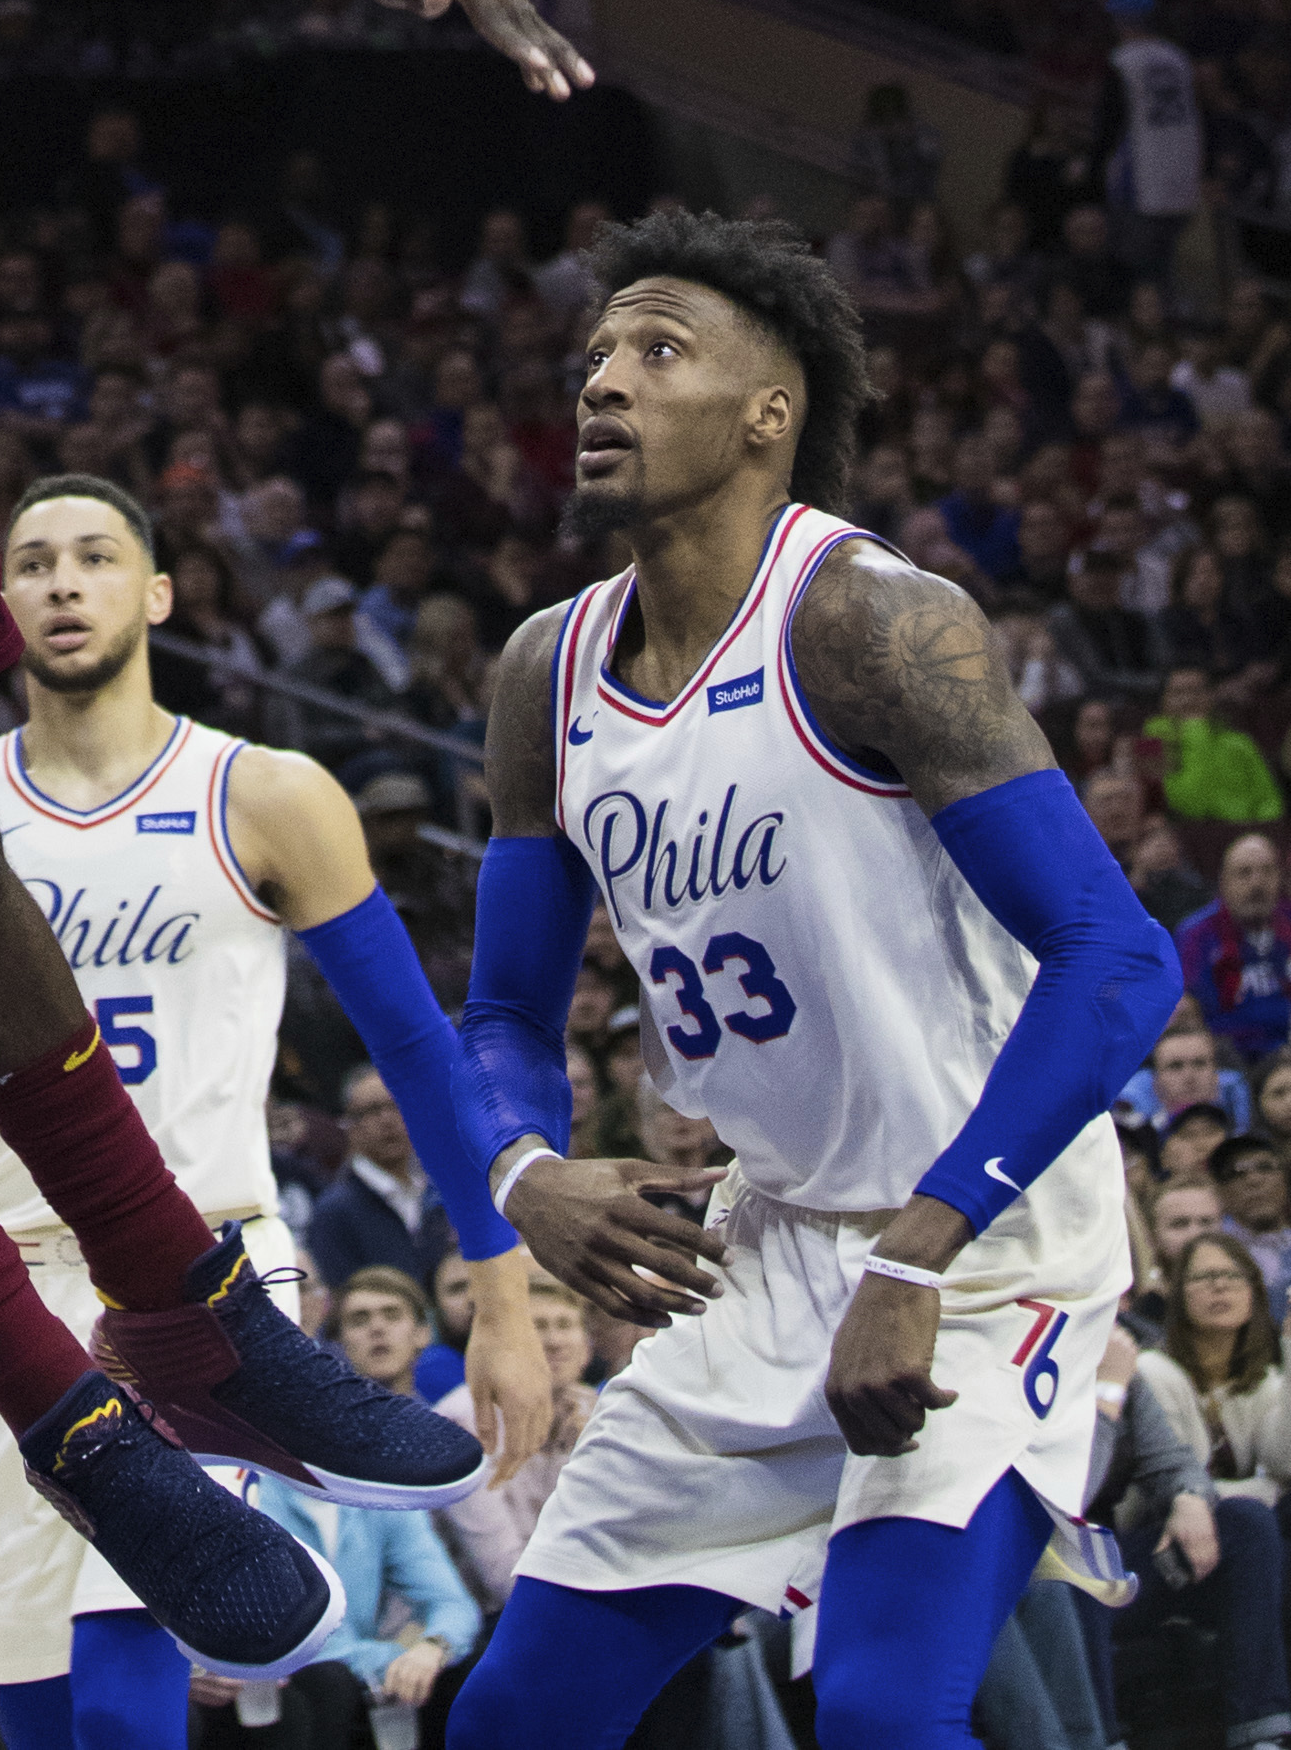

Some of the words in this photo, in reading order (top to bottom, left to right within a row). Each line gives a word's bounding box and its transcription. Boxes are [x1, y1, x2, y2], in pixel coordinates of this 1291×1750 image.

[715, 682, 760, 705] StubHub
[583, 784, 787, 929] Phila
[649, 931, 797, 1061] 33
